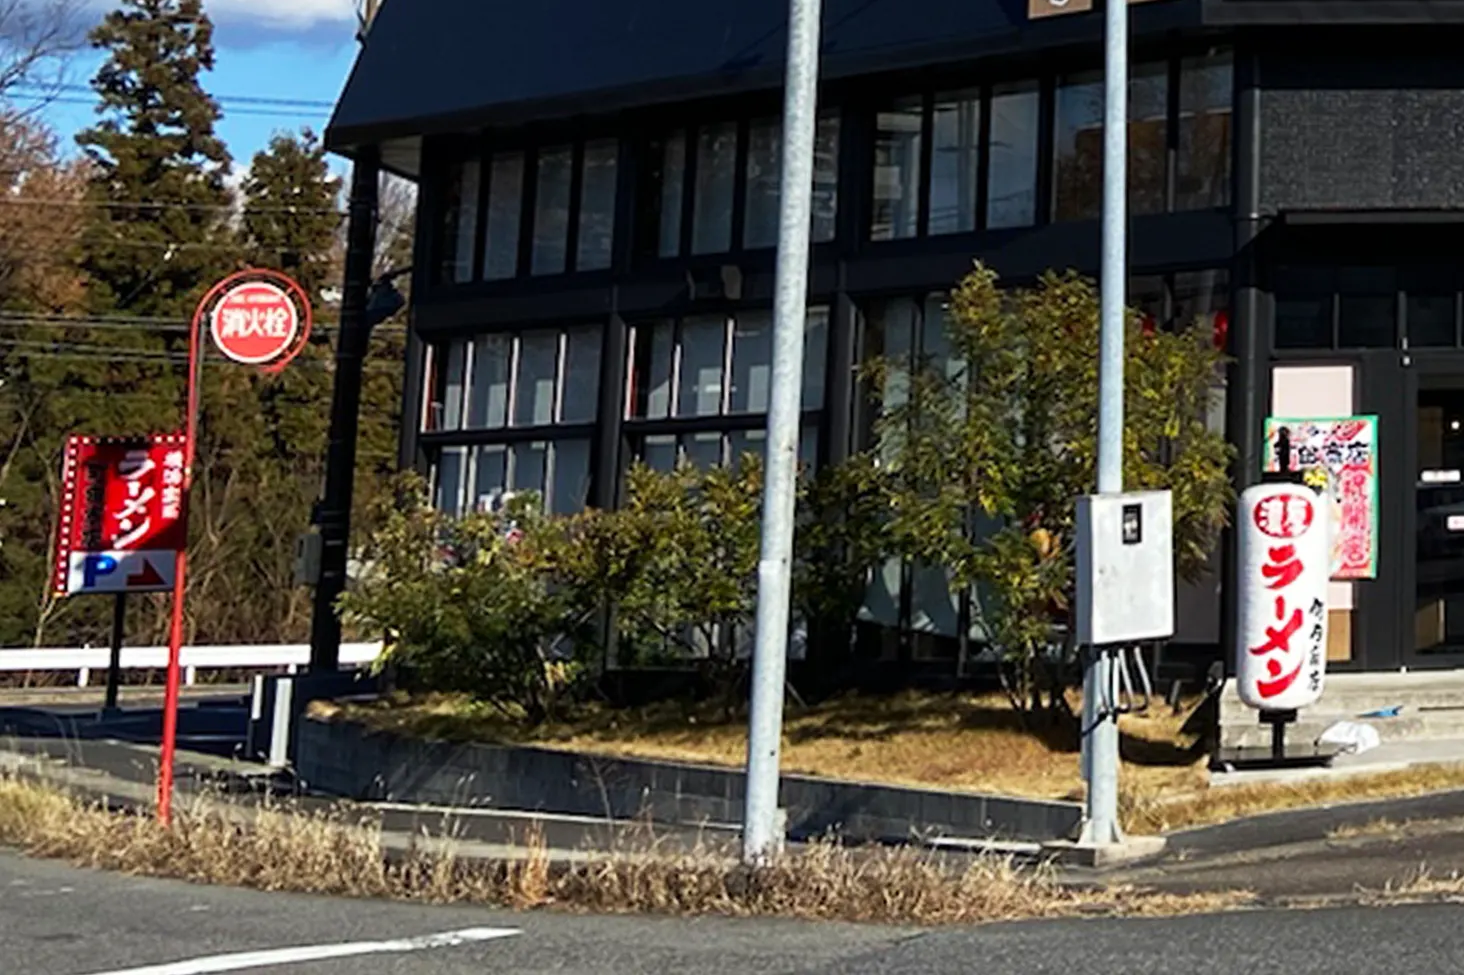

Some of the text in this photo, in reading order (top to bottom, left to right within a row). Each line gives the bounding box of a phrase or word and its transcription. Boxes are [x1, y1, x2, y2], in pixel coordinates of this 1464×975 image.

[221, 307, 287, 337] 消火栓
[111, 449, 156, 549] ラーメン
[83, 554, 118, 587] P
[1249, 543, 1304, 699] ラーメン
